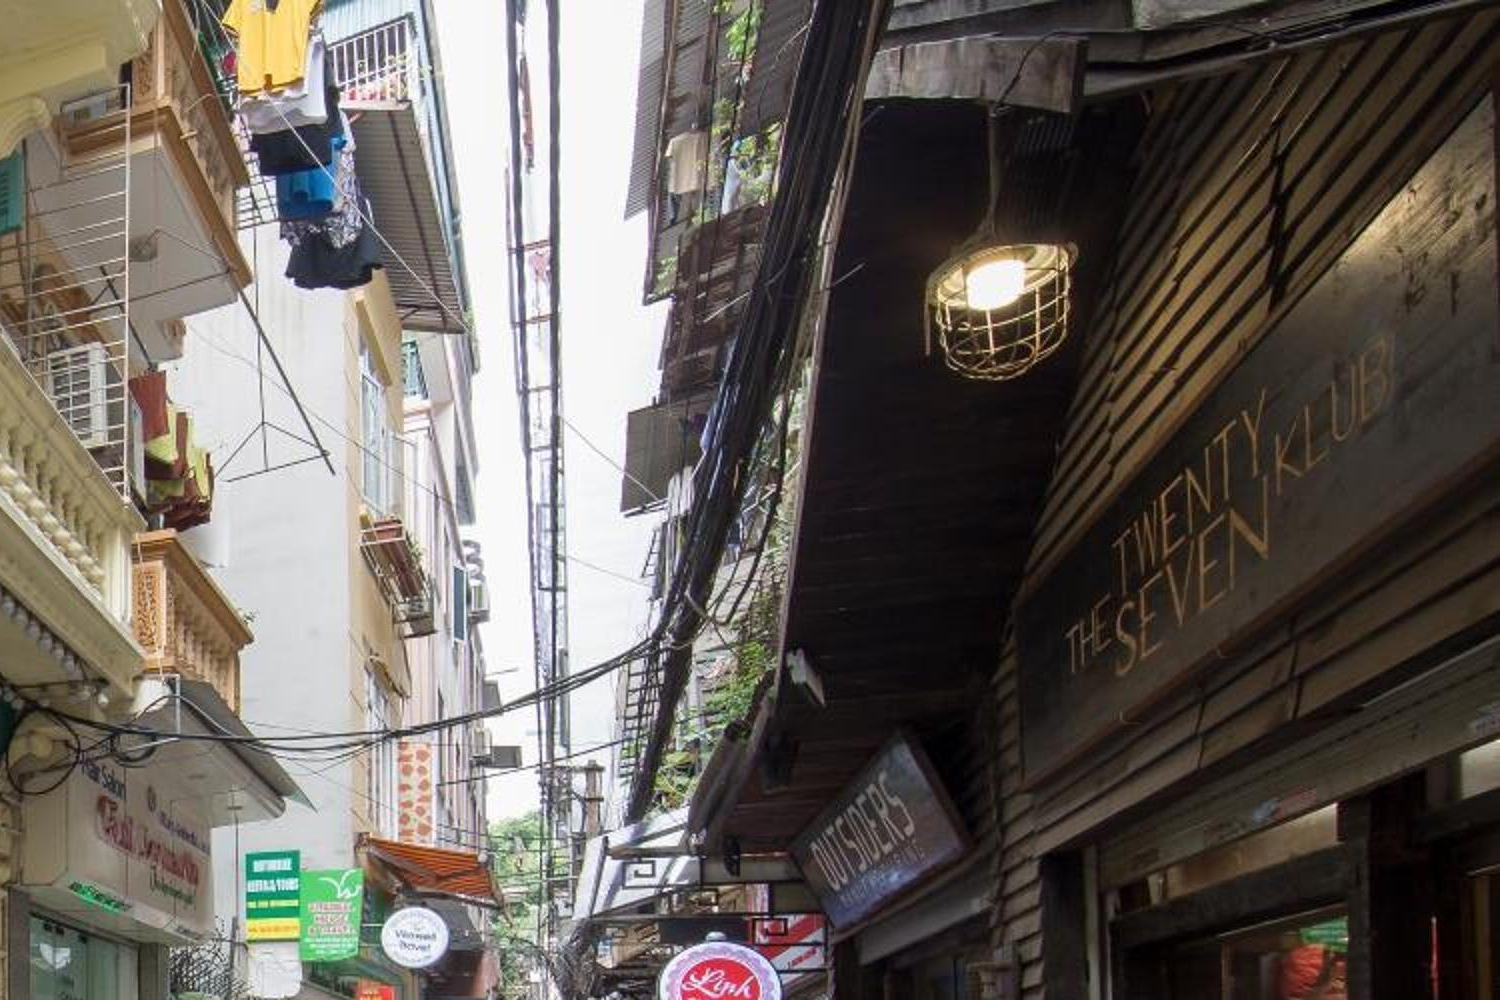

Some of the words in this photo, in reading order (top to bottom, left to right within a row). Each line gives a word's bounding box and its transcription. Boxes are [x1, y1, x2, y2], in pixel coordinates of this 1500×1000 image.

[1065, 593, 1110, 676] THE
[1112, 387, 1268, 596] TWENTY
[1114, 474, 1270, 678] SEVEN
[1274, 332, 1395, 496] KLUB
[810, 771, 915, 891] OUTSIDERS
